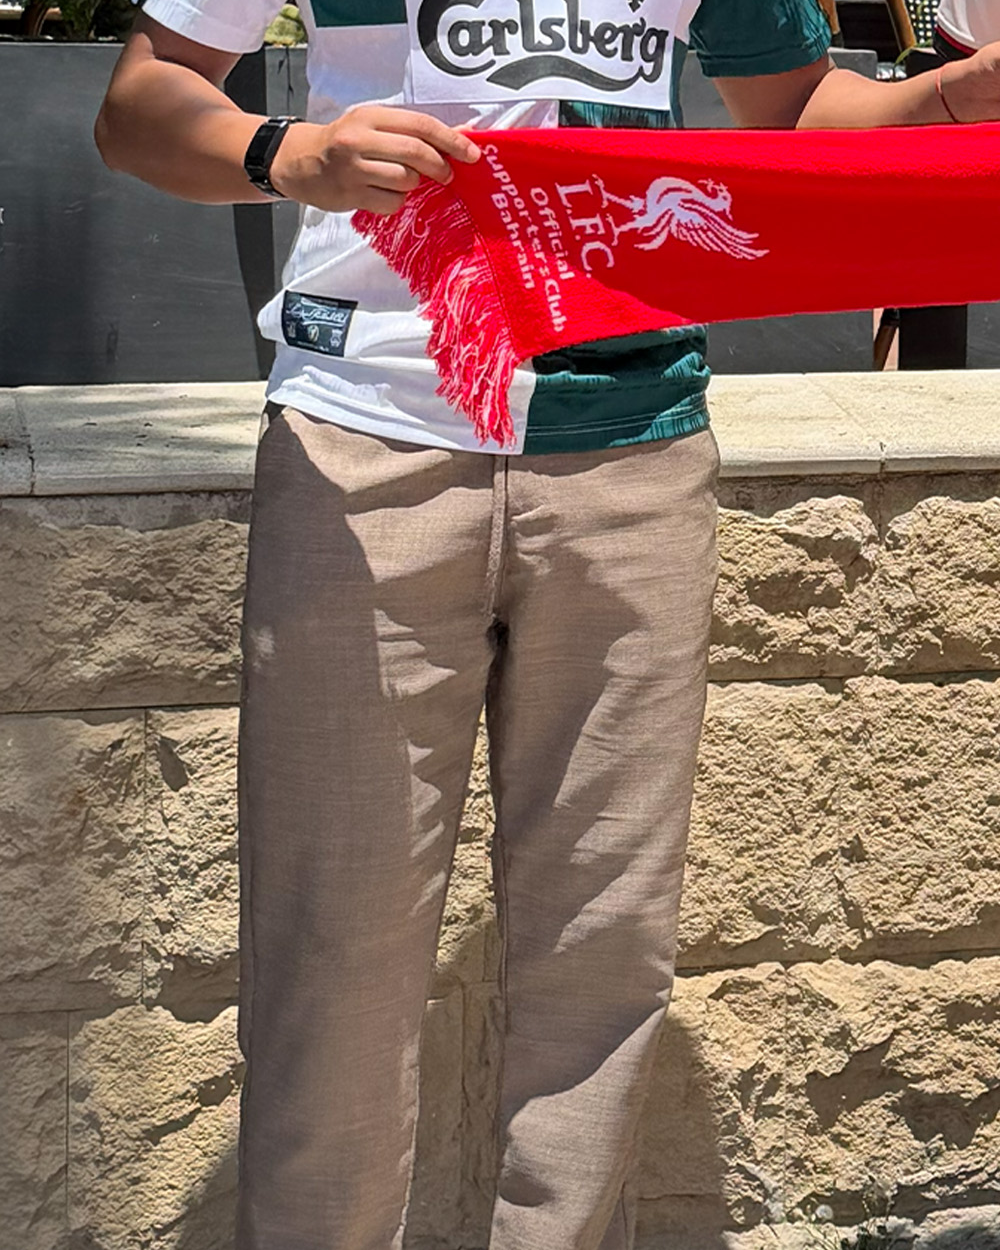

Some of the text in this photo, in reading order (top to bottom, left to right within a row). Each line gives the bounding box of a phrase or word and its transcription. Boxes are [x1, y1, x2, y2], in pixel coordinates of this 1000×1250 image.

[481, 143, 567, 332] Supporters Club
[491, 192, 535, 289] Bahrain
[530, 187, 575, 280] Official
[555, 179, 614, 278] L.F.C.
